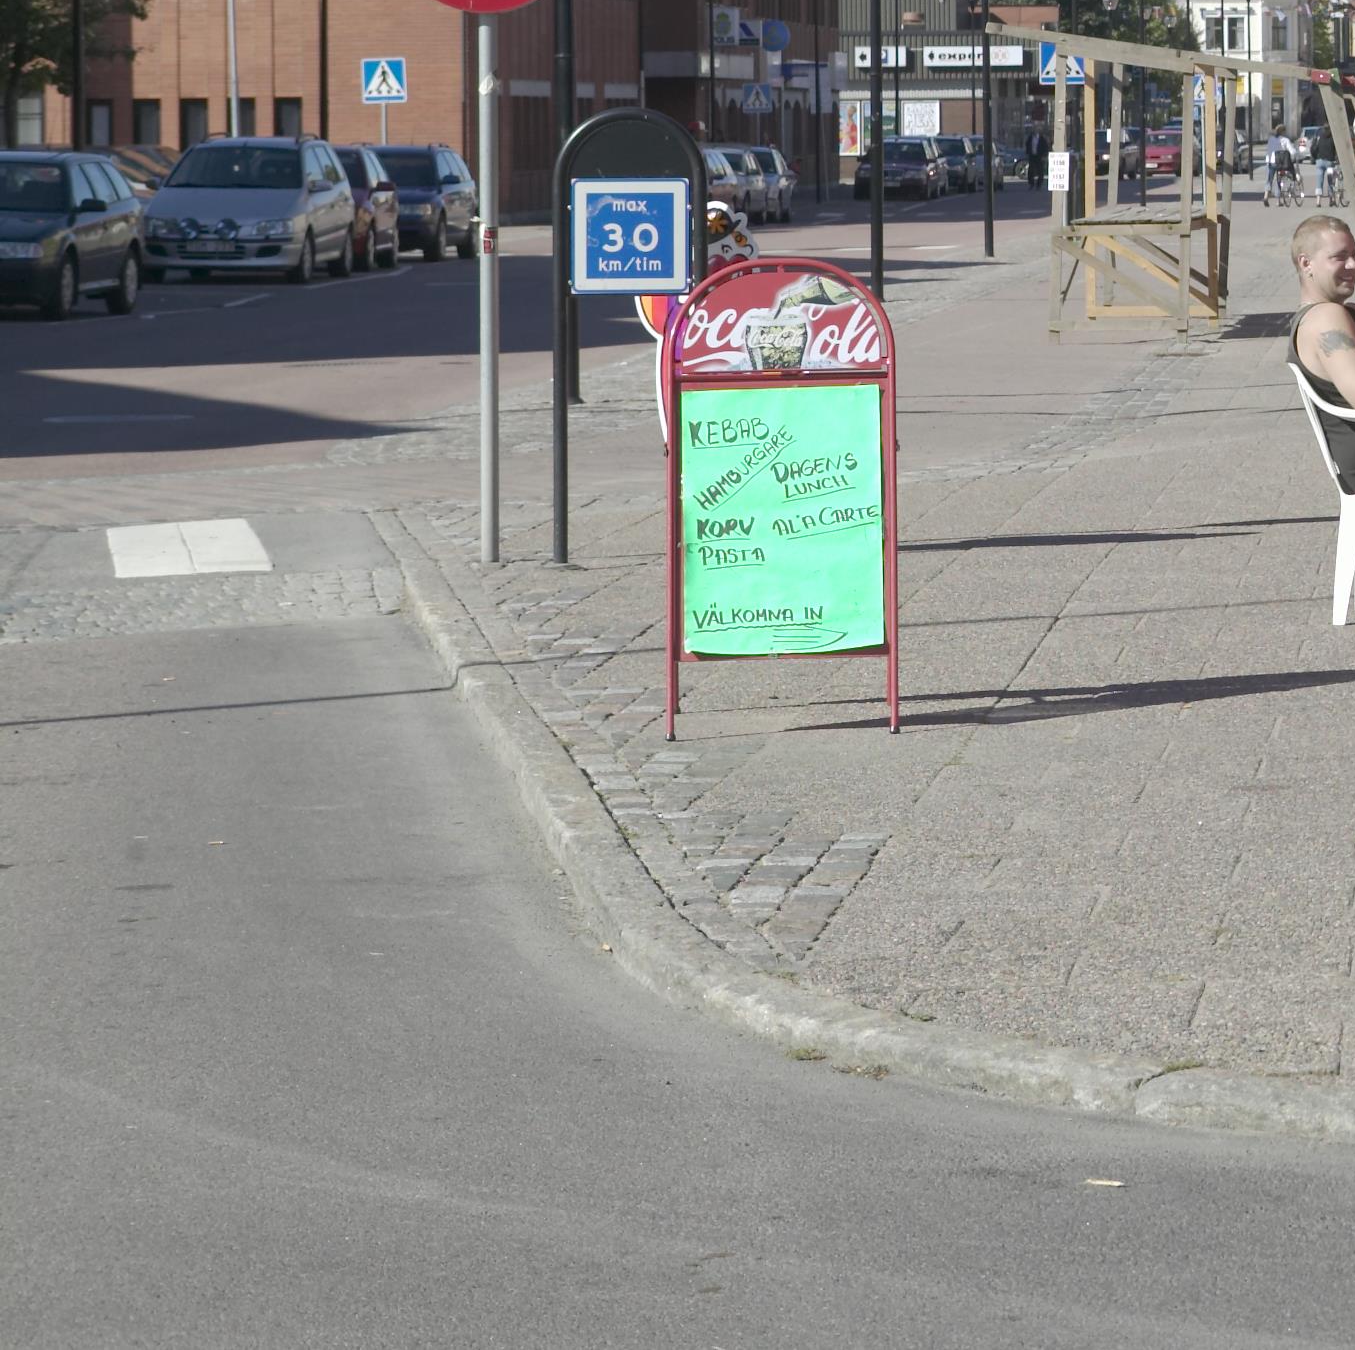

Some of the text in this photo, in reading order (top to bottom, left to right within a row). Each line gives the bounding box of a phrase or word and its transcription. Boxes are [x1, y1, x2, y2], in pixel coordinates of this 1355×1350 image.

[612, 199, 647, 211] max
[602, 223, 659, 252] 30
[599, 257, 661, 271] km/tim
[688, 417, 769, 447] KEBAB
[693, 424, 793, 510] HAMBURGARE
[770, 453, 858, 483] DAGENS
[784, 475, 850, 499] LUNCH
[697, 516, 755, 540] KORV
[698, 545, 766, 565] PASTA
[693, 603, 823, 628] VÄLKOMNA IN
